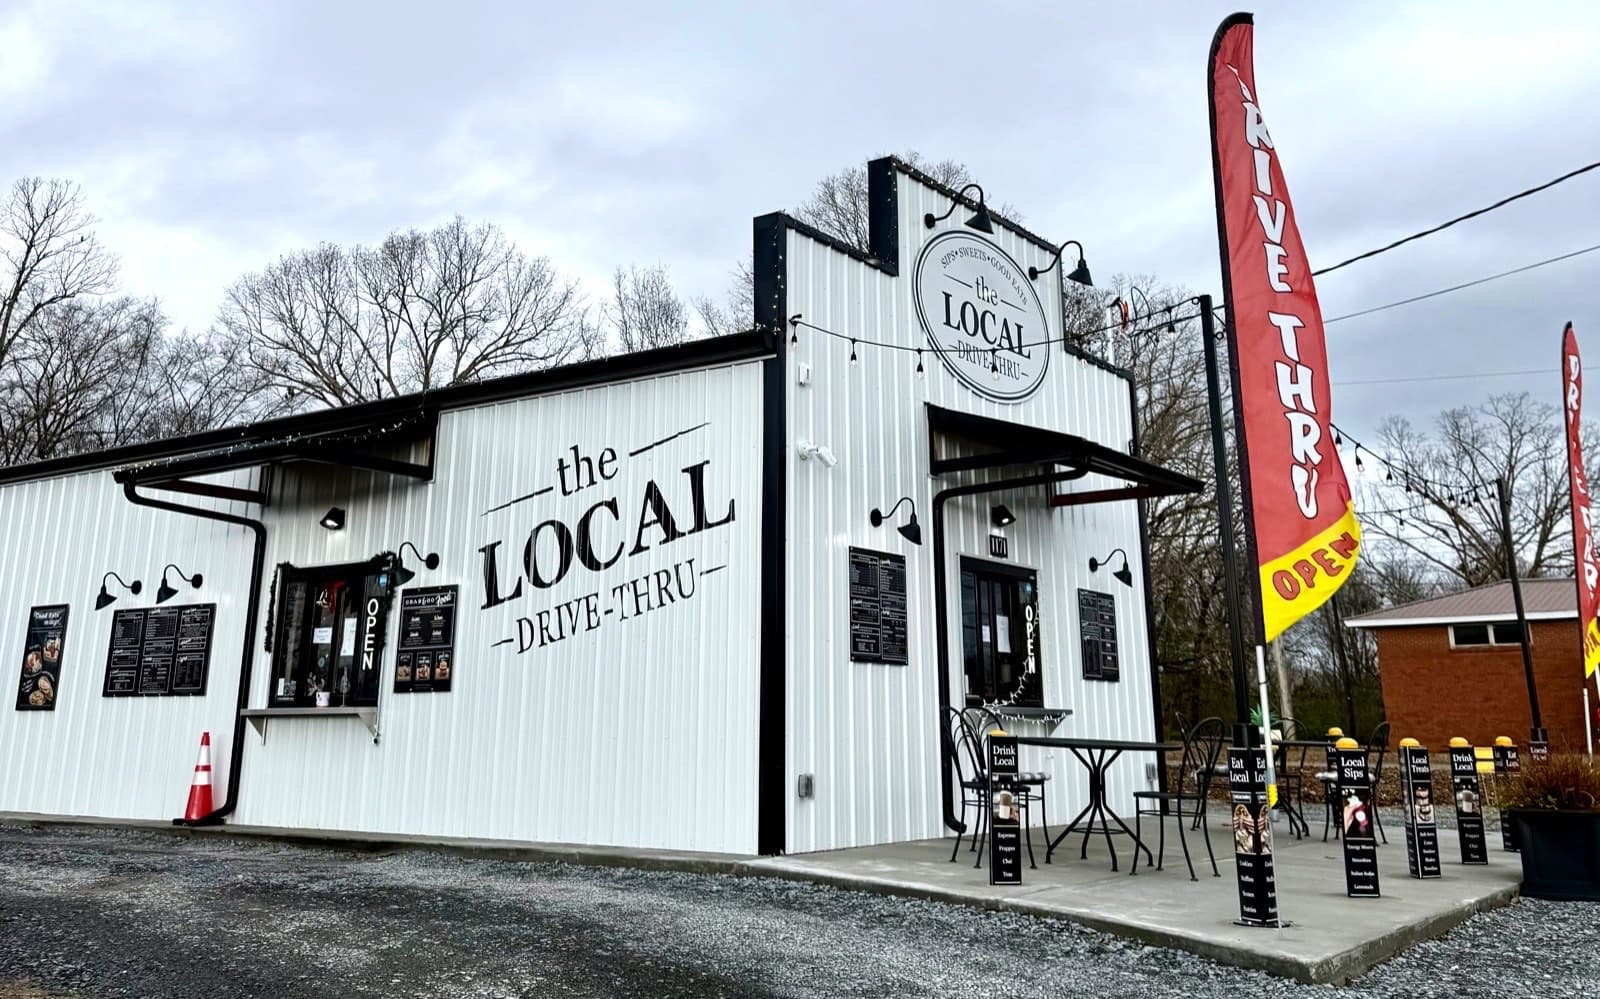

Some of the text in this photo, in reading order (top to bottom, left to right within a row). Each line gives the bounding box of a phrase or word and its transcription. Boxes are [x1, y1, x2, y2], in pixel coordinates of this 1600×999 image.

[1226, 63, 1293, 293] RIVE
[958, 247, 987, 261] SWEETS
[990, 256, 1012, 281] GOOD
[1011, 277, 1028, 306] EATS
[975, 275, 998, 306] the
[942, 290, 1031, 360] LOCAL
[1268, 310, 1323, 520] THRU
[556, 444, 619, 497] the
[478, 459, 736, 611] LOCAL
[1272, 531, 1360, 602] OPEN
[516, 558, 696, 654] DRIVE-THRU
[362, 598, 379, 672] OPEN
[1025, 604, 1036, 674] OPEN
[993, 745, 1016, 756] Drink
[994, 756, 1015, 766] Local
[1231, 757, 1245, 769] Eat
[1341, 756, 1366, 767] Local
[1412, 755, 1428, 764] Local
[1452, 754, 1474, 763] Drink
[1454, 763, 1474, 771] Local
[1230, 770, 1250, 783] Local
[1344, 768, 1364, 780] Sips
